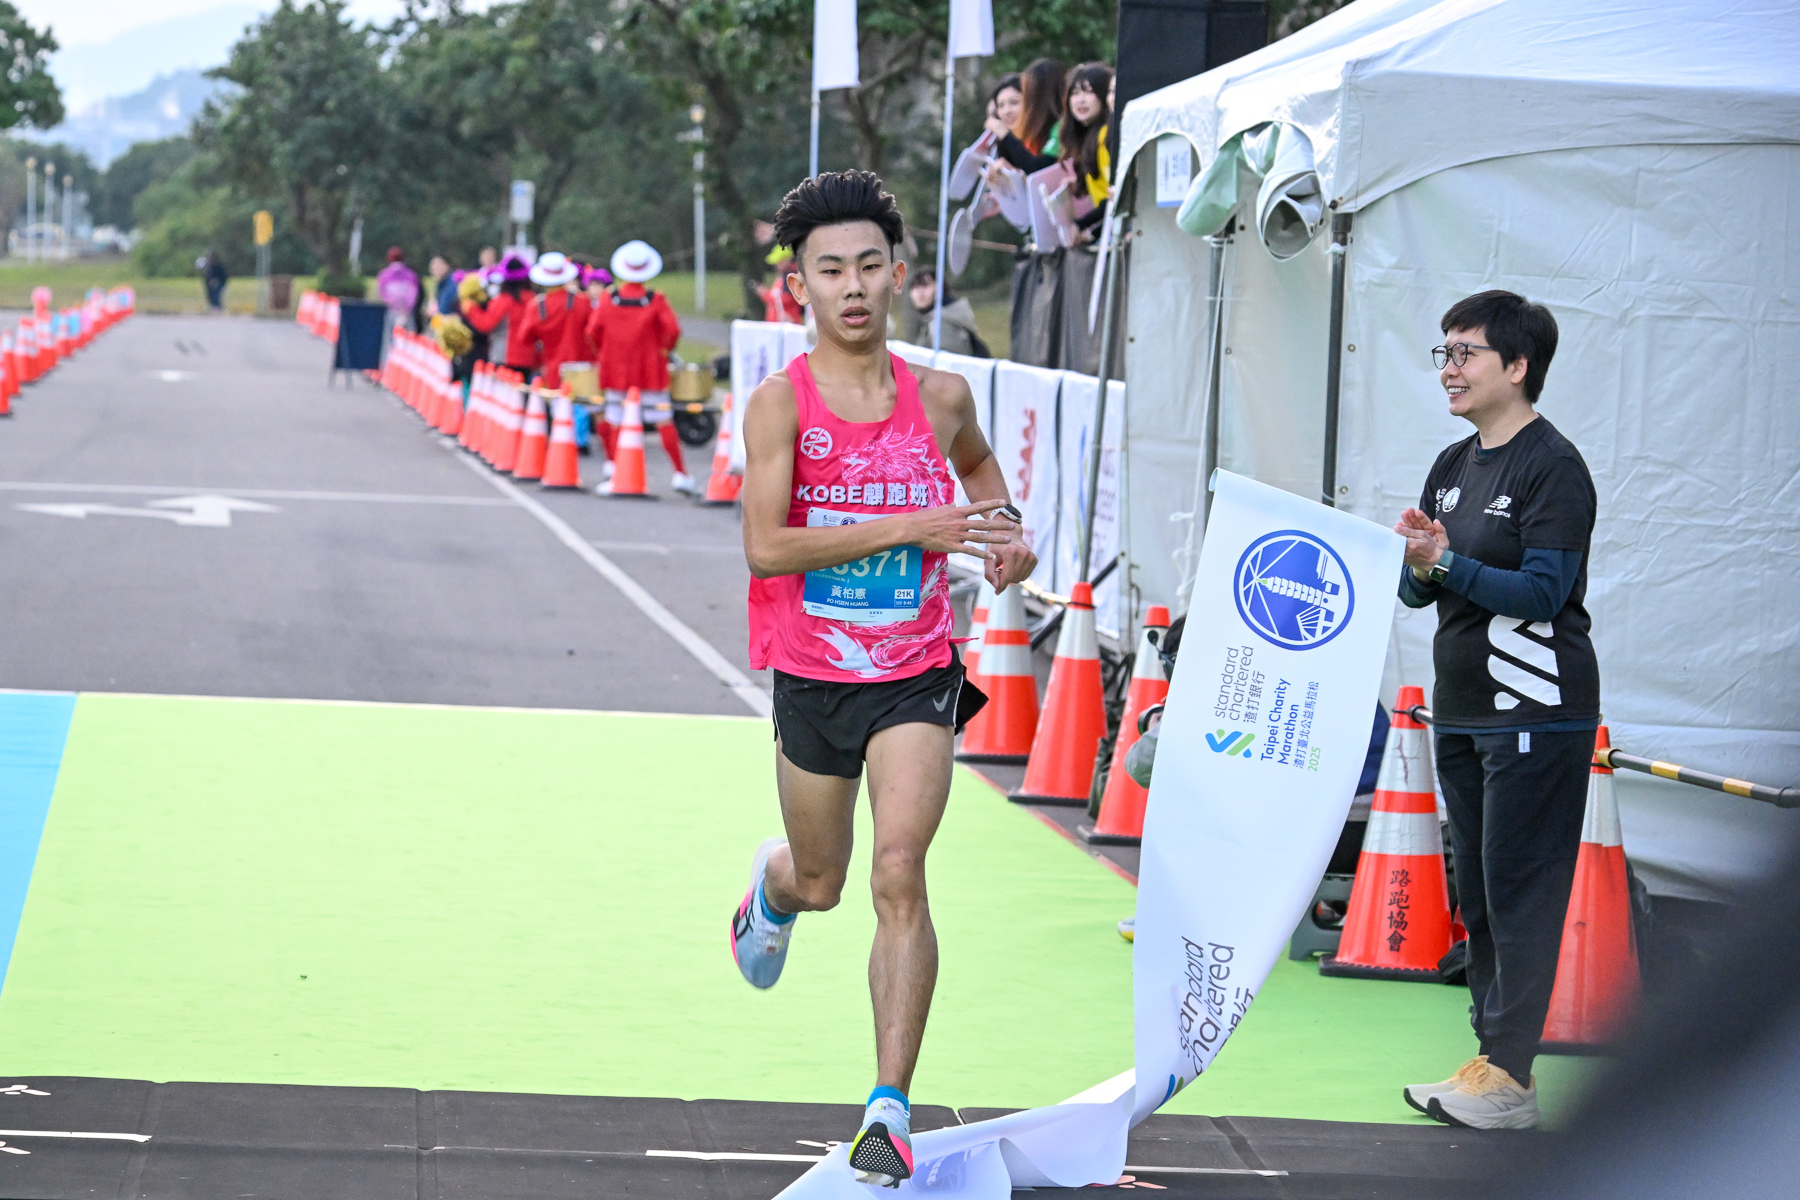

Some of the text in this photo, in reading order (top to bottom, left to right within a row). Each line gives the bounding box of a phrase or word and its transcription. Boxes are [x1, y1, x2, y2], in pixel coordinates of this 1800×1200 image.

[896, 590, 912, 598] 21K
[1214, 646, 1240, 719] standard
[1228, 645, 1254, 721] chartered
[1243, 670, 1266, 724] 渣打銀行
[1260, 677, 1292, 762] Taipei Charity
[1277, 703, 1300, 765] Marathon
[1307, 746, 1322, 773] 2025
[1387, 868, 1412, 952] 路跑協會
[1177, 935, 1204, 1058] standard
[1191, 942, 1235, 1077] chartered
